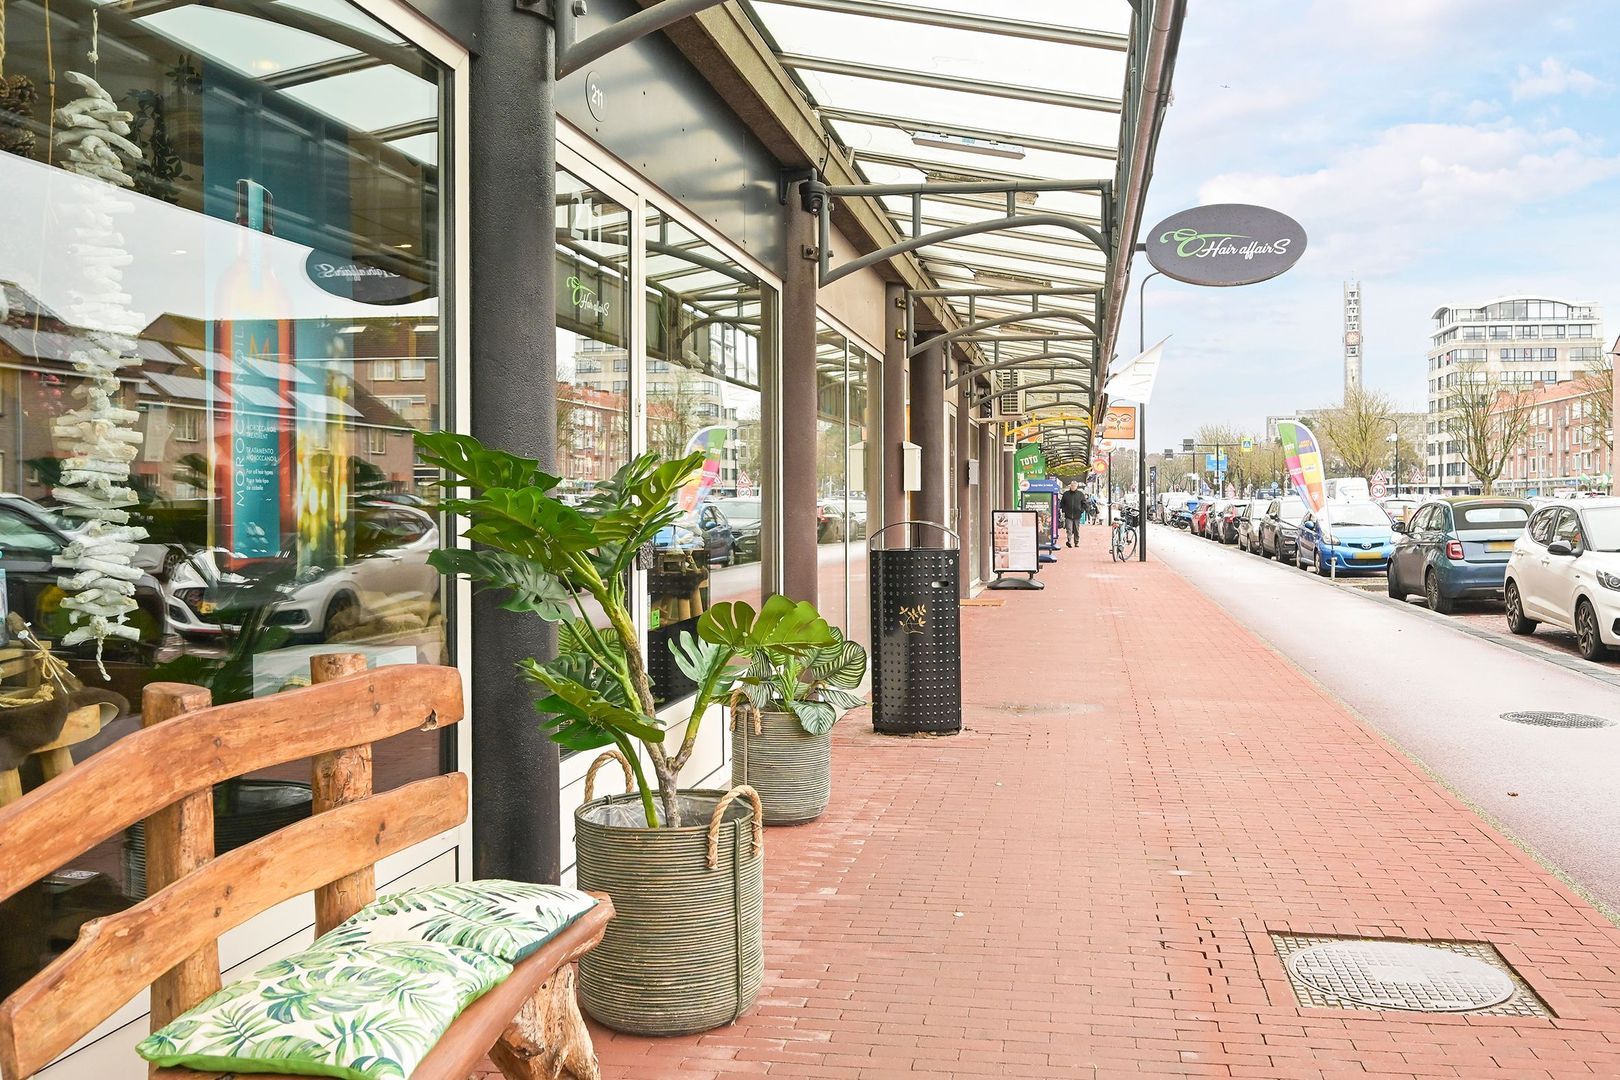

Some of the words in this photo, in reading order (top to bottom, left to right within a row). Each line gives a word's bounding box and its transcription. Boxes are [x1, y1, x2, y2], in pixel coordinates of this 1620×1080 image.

[591, 84, 603, 110] 211
[1196, 237, 1238, 258] Hair
[1239, 238, 1291, 260] affairS
[235, 326, 245, 507] MOROCCNOIL
[1020, 455, 1038, 466] TOTO
